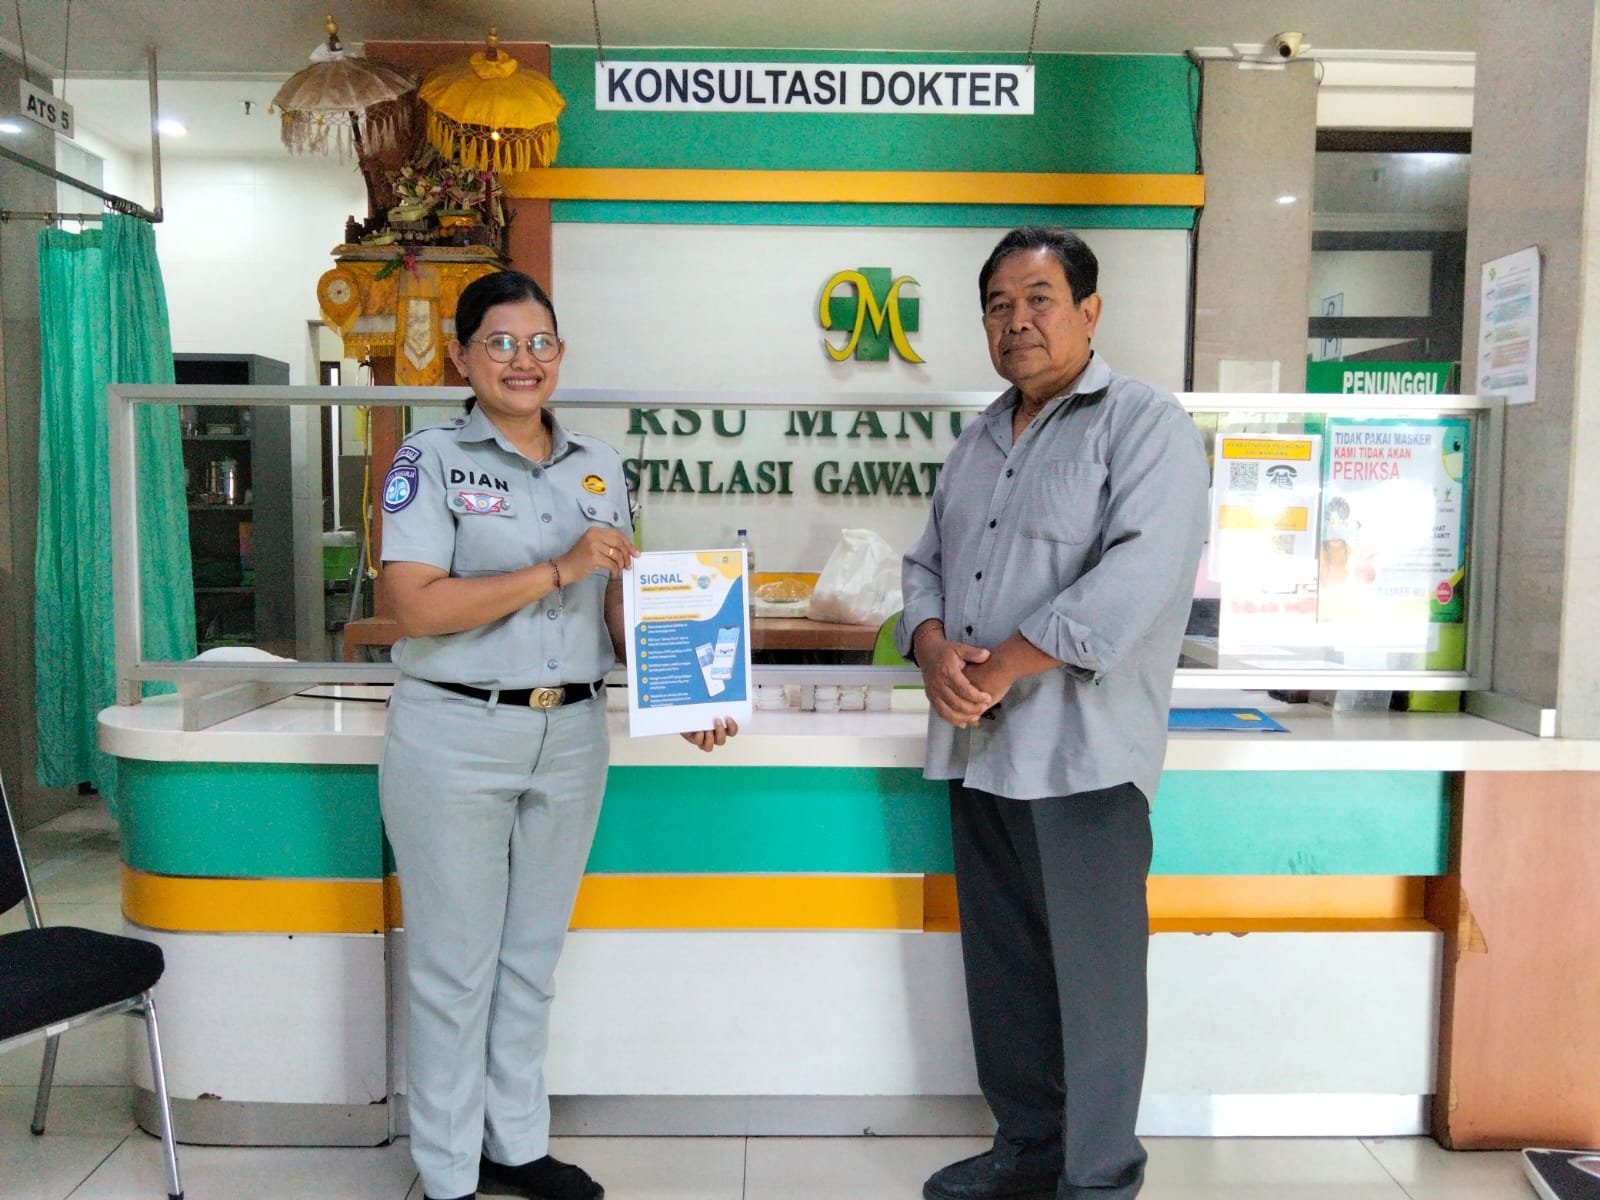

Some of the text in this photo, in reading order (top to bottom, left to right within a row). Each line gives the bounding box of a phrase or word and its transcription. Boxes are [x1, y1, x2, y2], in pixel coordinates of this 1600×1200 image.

[608, 68, 1019, 106] KONSULTASI DOKTER
[27, 94, 69, 130] ATS 5
[1342, 371, 1438, 394] PENUNGGU
[1335, 432, 1432, 445] TIDAK PAKAI MASKER
[1334, 447, 1411, 459] KAMI TIDAK AKAN
[450, 469, 509, 492] DIAN
[1333, 461, 1400, 480] PERIKSA
[640, 573, 682, 585] SIGNAL
